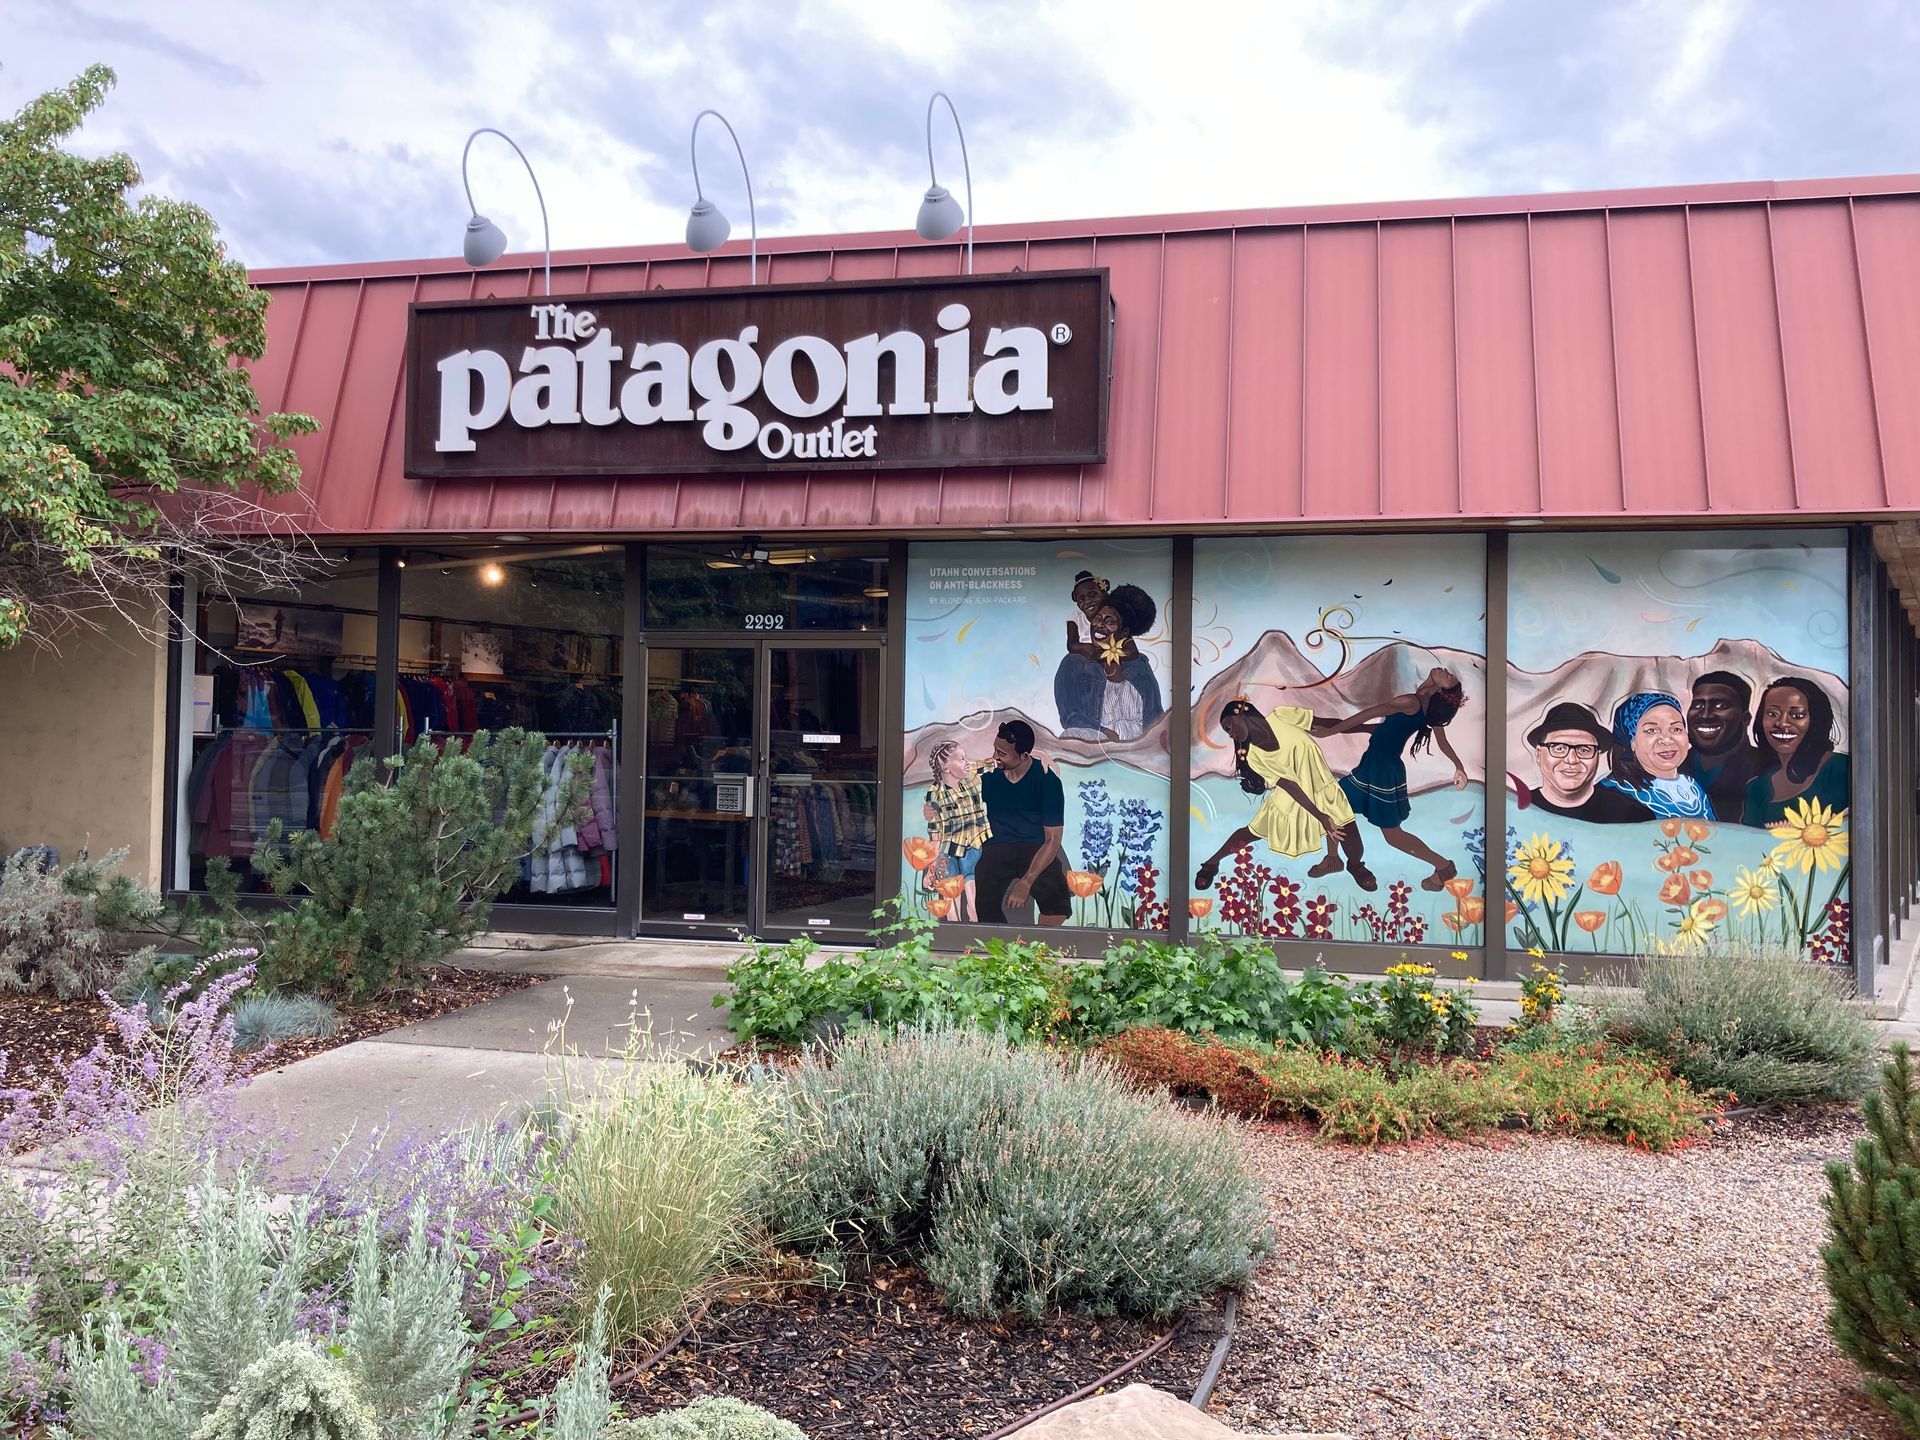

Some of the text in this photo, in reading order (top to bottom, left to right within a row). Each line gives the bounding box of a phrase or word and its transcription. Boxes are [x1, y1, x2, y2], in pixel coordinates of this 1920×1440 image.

[530, 303, 597, 342] The
[435, 303, 1054, 453] patagonia
[757, 417, 878, 459] Outlet
[929, 566, 1037, 577] UTAHN CONVERSATIONS
[929, 580, 1023, 590] ON ANTI-BLACKNESS
[939, 596, 974, 605] BLONDNE
[744, 614, 784, 630] 2292
